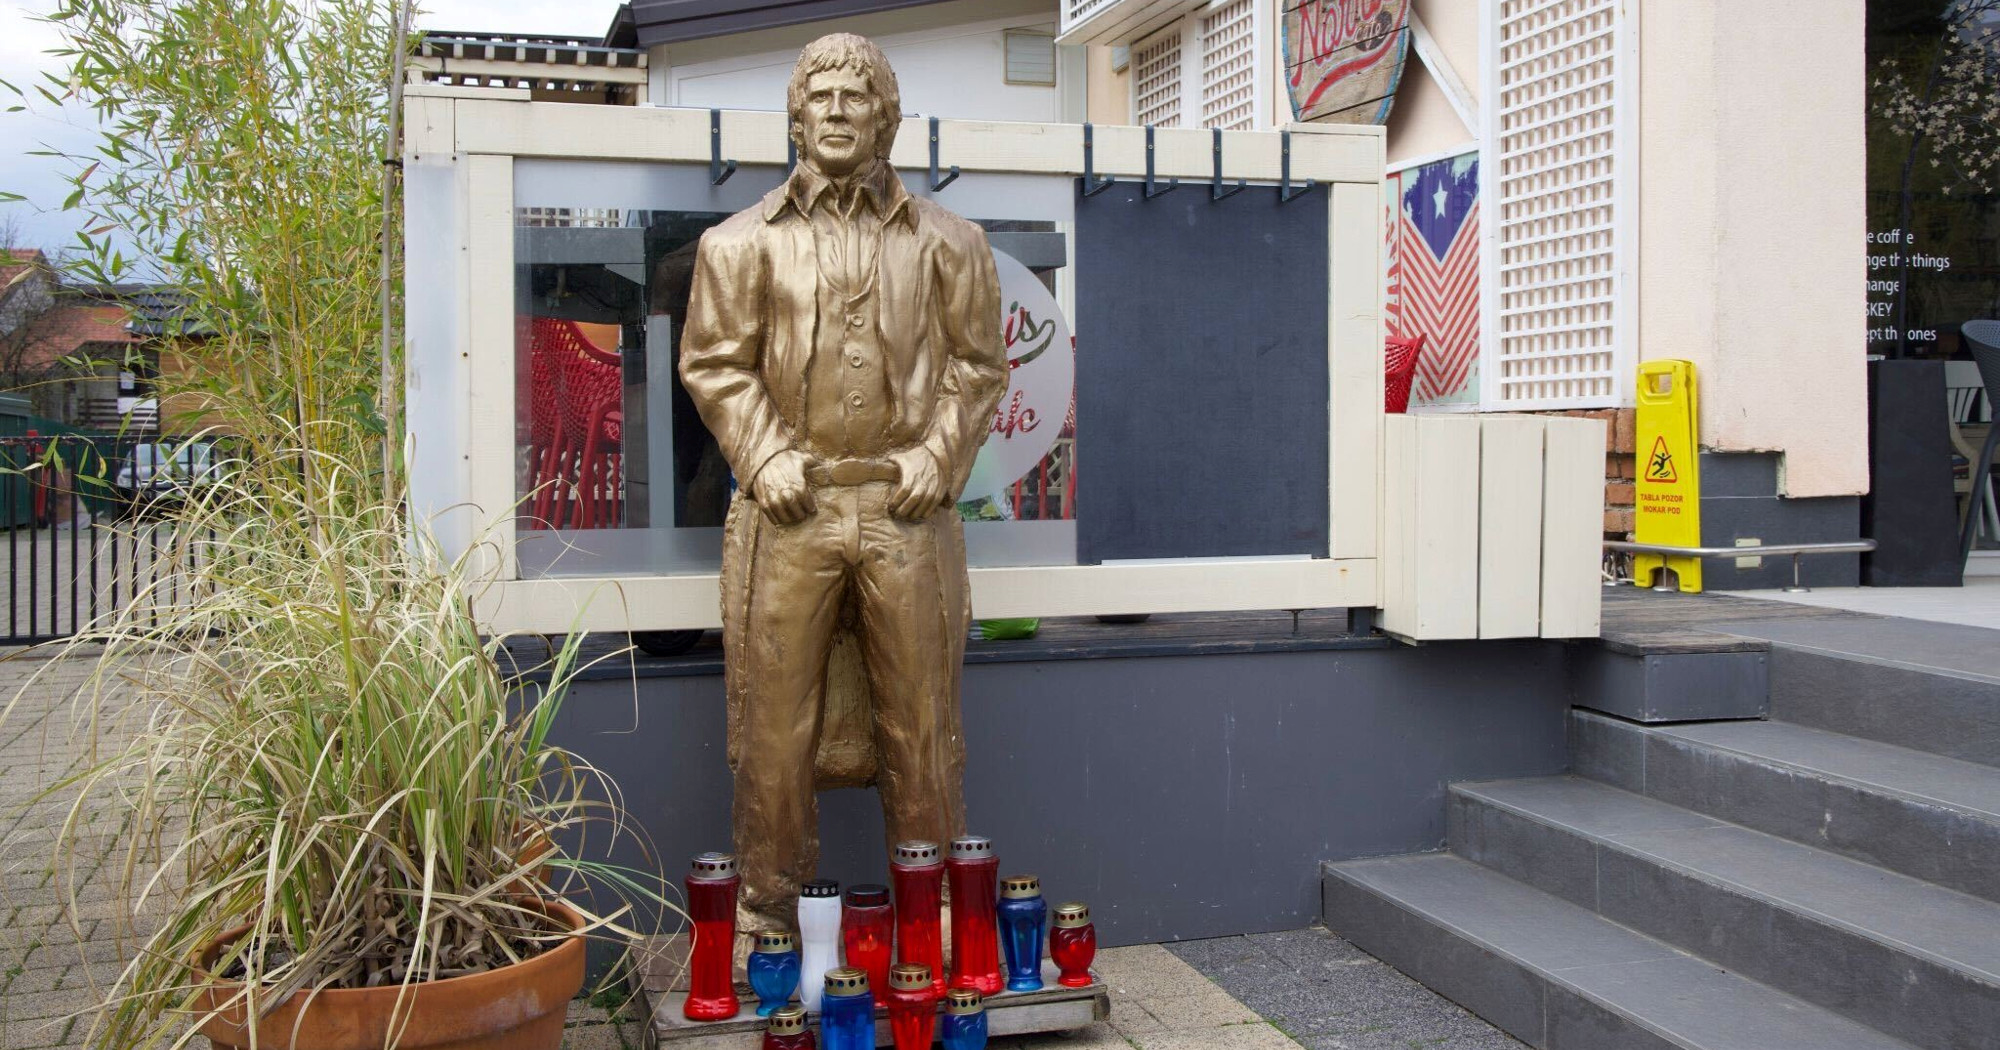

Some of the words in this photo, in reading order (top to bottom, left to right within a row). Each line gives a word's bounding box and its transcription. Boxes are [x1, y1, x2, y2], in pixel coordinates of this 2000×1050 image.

[1866, 232, 1874, 244] e
[1877, 228, 1914, 244] coffe
[1866, 255, 1887, 270] nge
[1912, 252, 1950, 271] things
[1866, 280, 1900, 296] ange
[1866, 302, 1893, 317] SKEY
[1885, 325, 1899, 340] th
[1907, 329, 1937, 341] ones
[990, 390, 1041, 439] afe
[1640, 493, 1660, 502] TABLA
[1661, 494, 1683, 503] POZOR
[1643, 505, 1666, 514] MOKAR
[1667, 506, 1681, 515] POD
